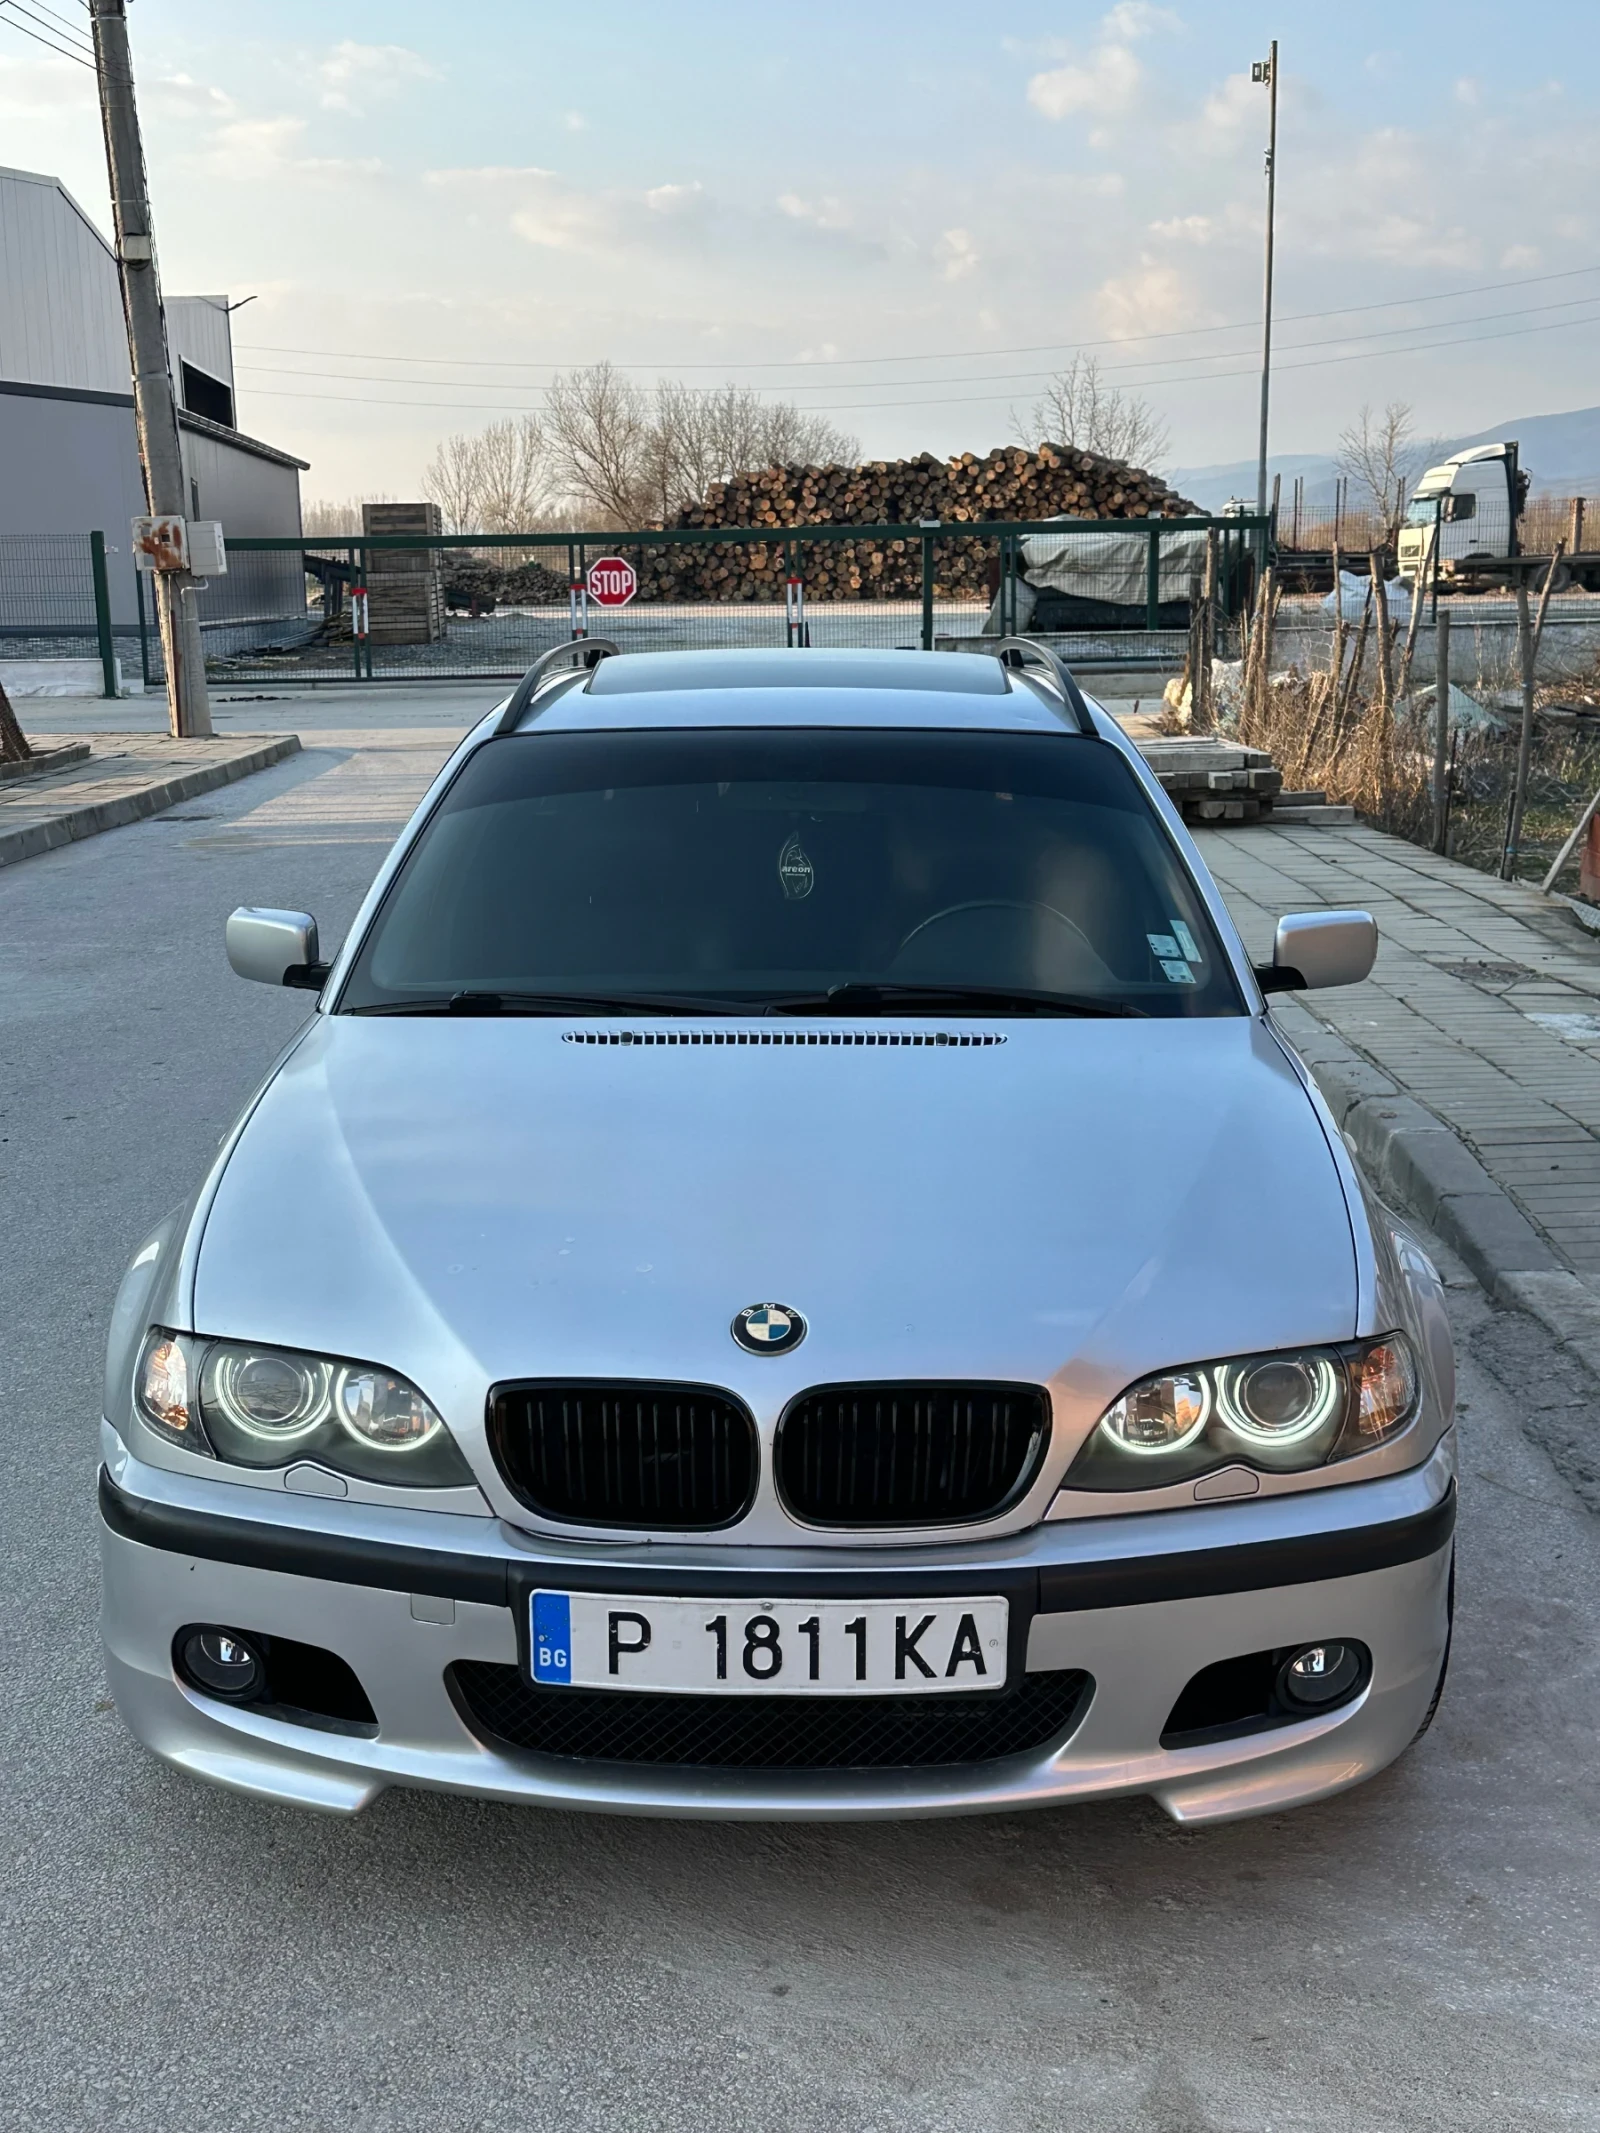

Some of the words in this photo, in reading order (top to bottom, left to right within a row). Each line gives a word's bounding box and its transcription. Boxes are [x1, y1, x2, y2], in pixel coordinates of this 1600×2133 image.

[591, 570, 632, 596] STOP
[741, 1303, 798, 1318] BMW
[607, 1610, 652, 1675] P
[538, 1647, 567, 1668] BG
